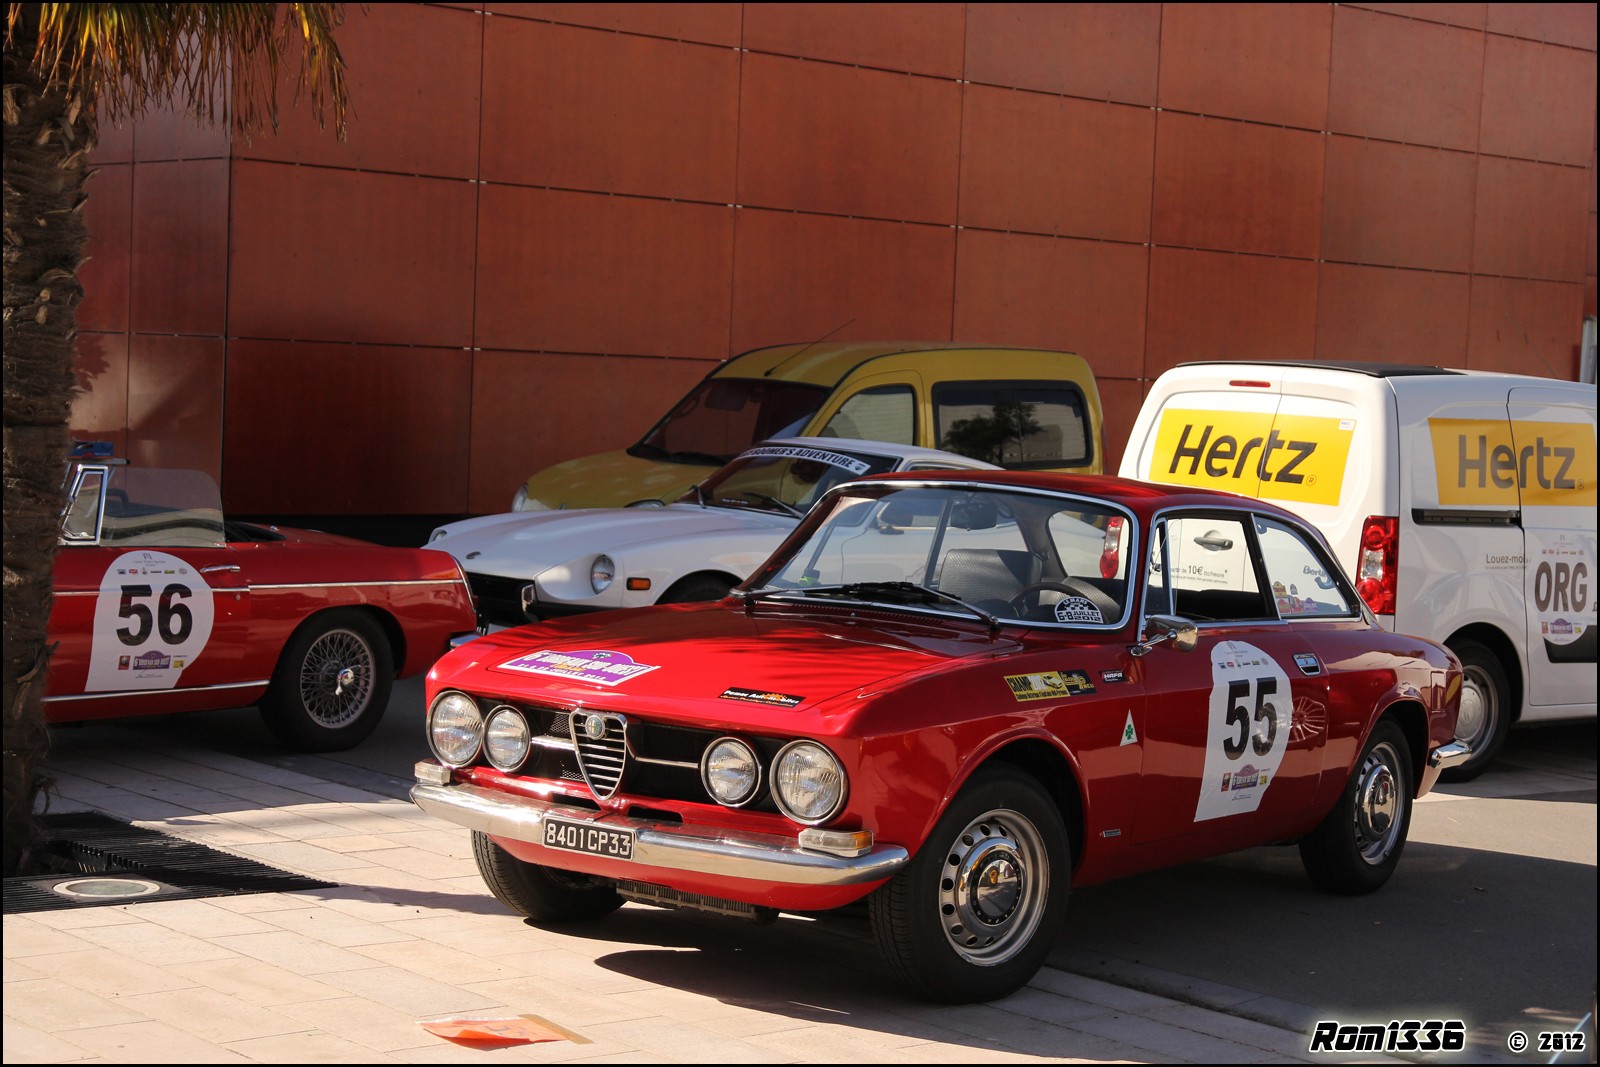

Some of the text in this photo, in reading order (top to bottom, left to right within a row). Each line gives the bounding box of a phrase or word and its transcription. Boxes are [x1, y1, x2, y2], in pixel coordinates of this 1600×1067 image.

[795, 447, 854, 469] ADVENTURE
[1168, 424, 1318, 485] Hertz
[1458, 434, 1576, 490] Hertz
[1188, 565, 1204, 576] 10€
[1535, 561, 1588, 612] ORG
[116, 583, 193, 647] 56
[1223, 677, 1277, 761] 55
[546, 823, 632, 856] 8401CP33
